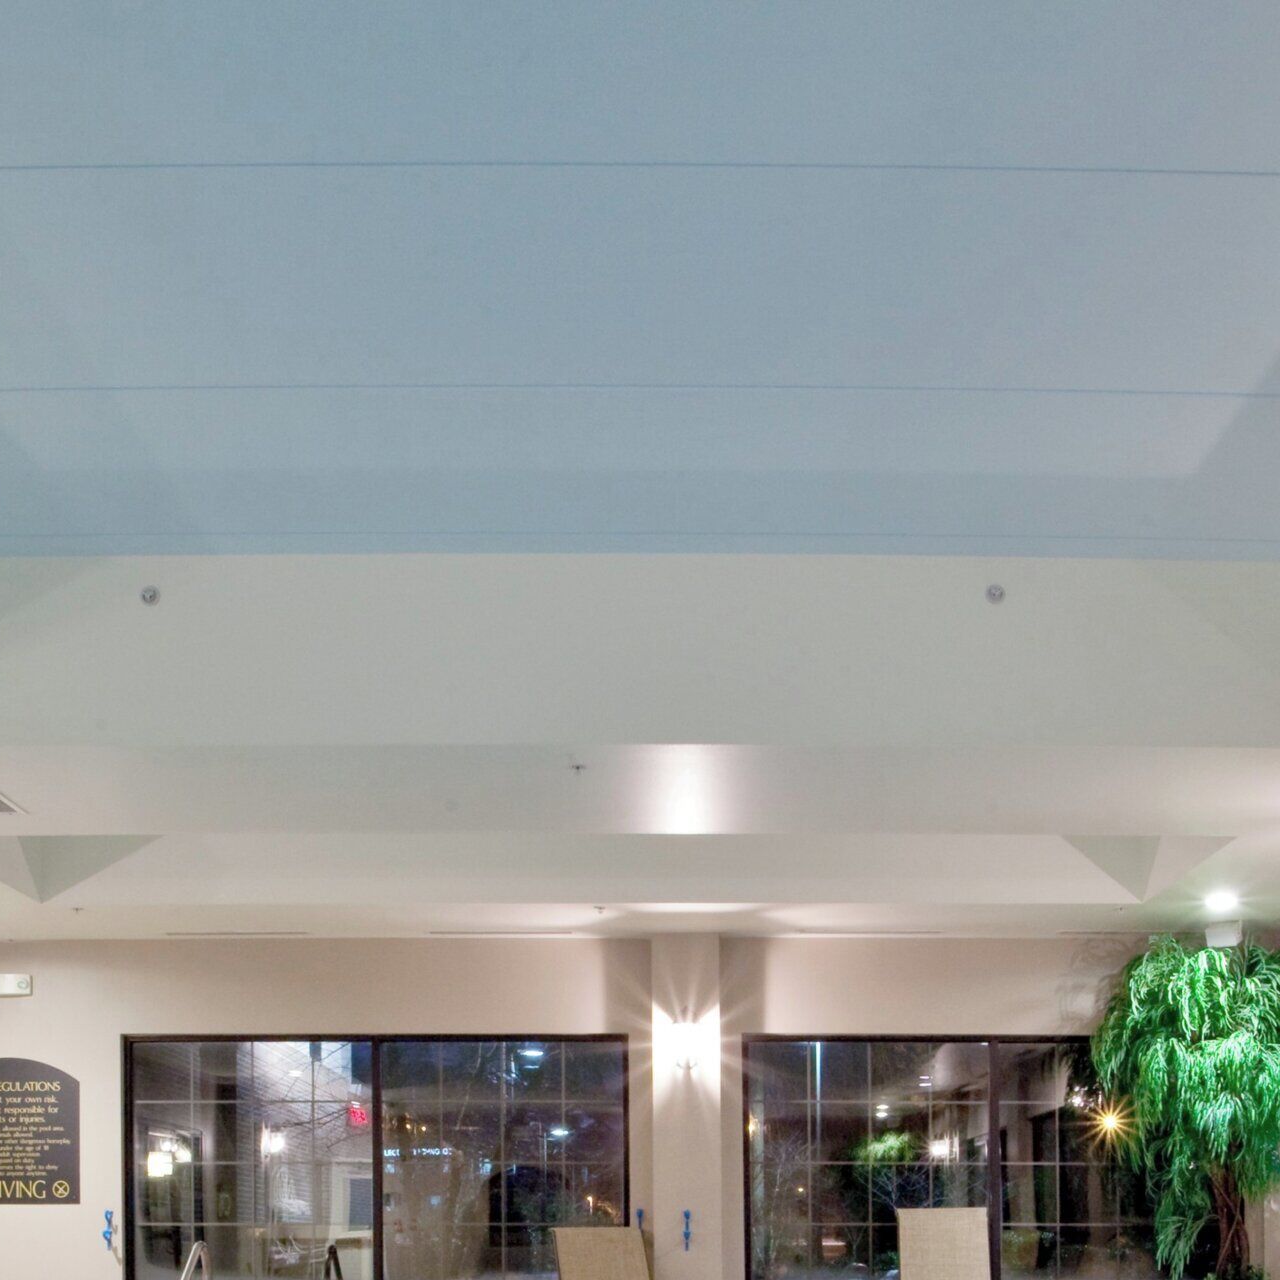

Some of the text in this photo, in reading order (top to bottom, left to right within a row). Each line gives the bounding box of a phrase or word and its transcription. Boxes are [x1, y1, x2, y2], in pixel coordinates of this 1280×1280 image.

[5, 1096, 22, 1105] your
[4, 1105, 45, 1115] responsible
[48, 1105, 59, 1114] for
